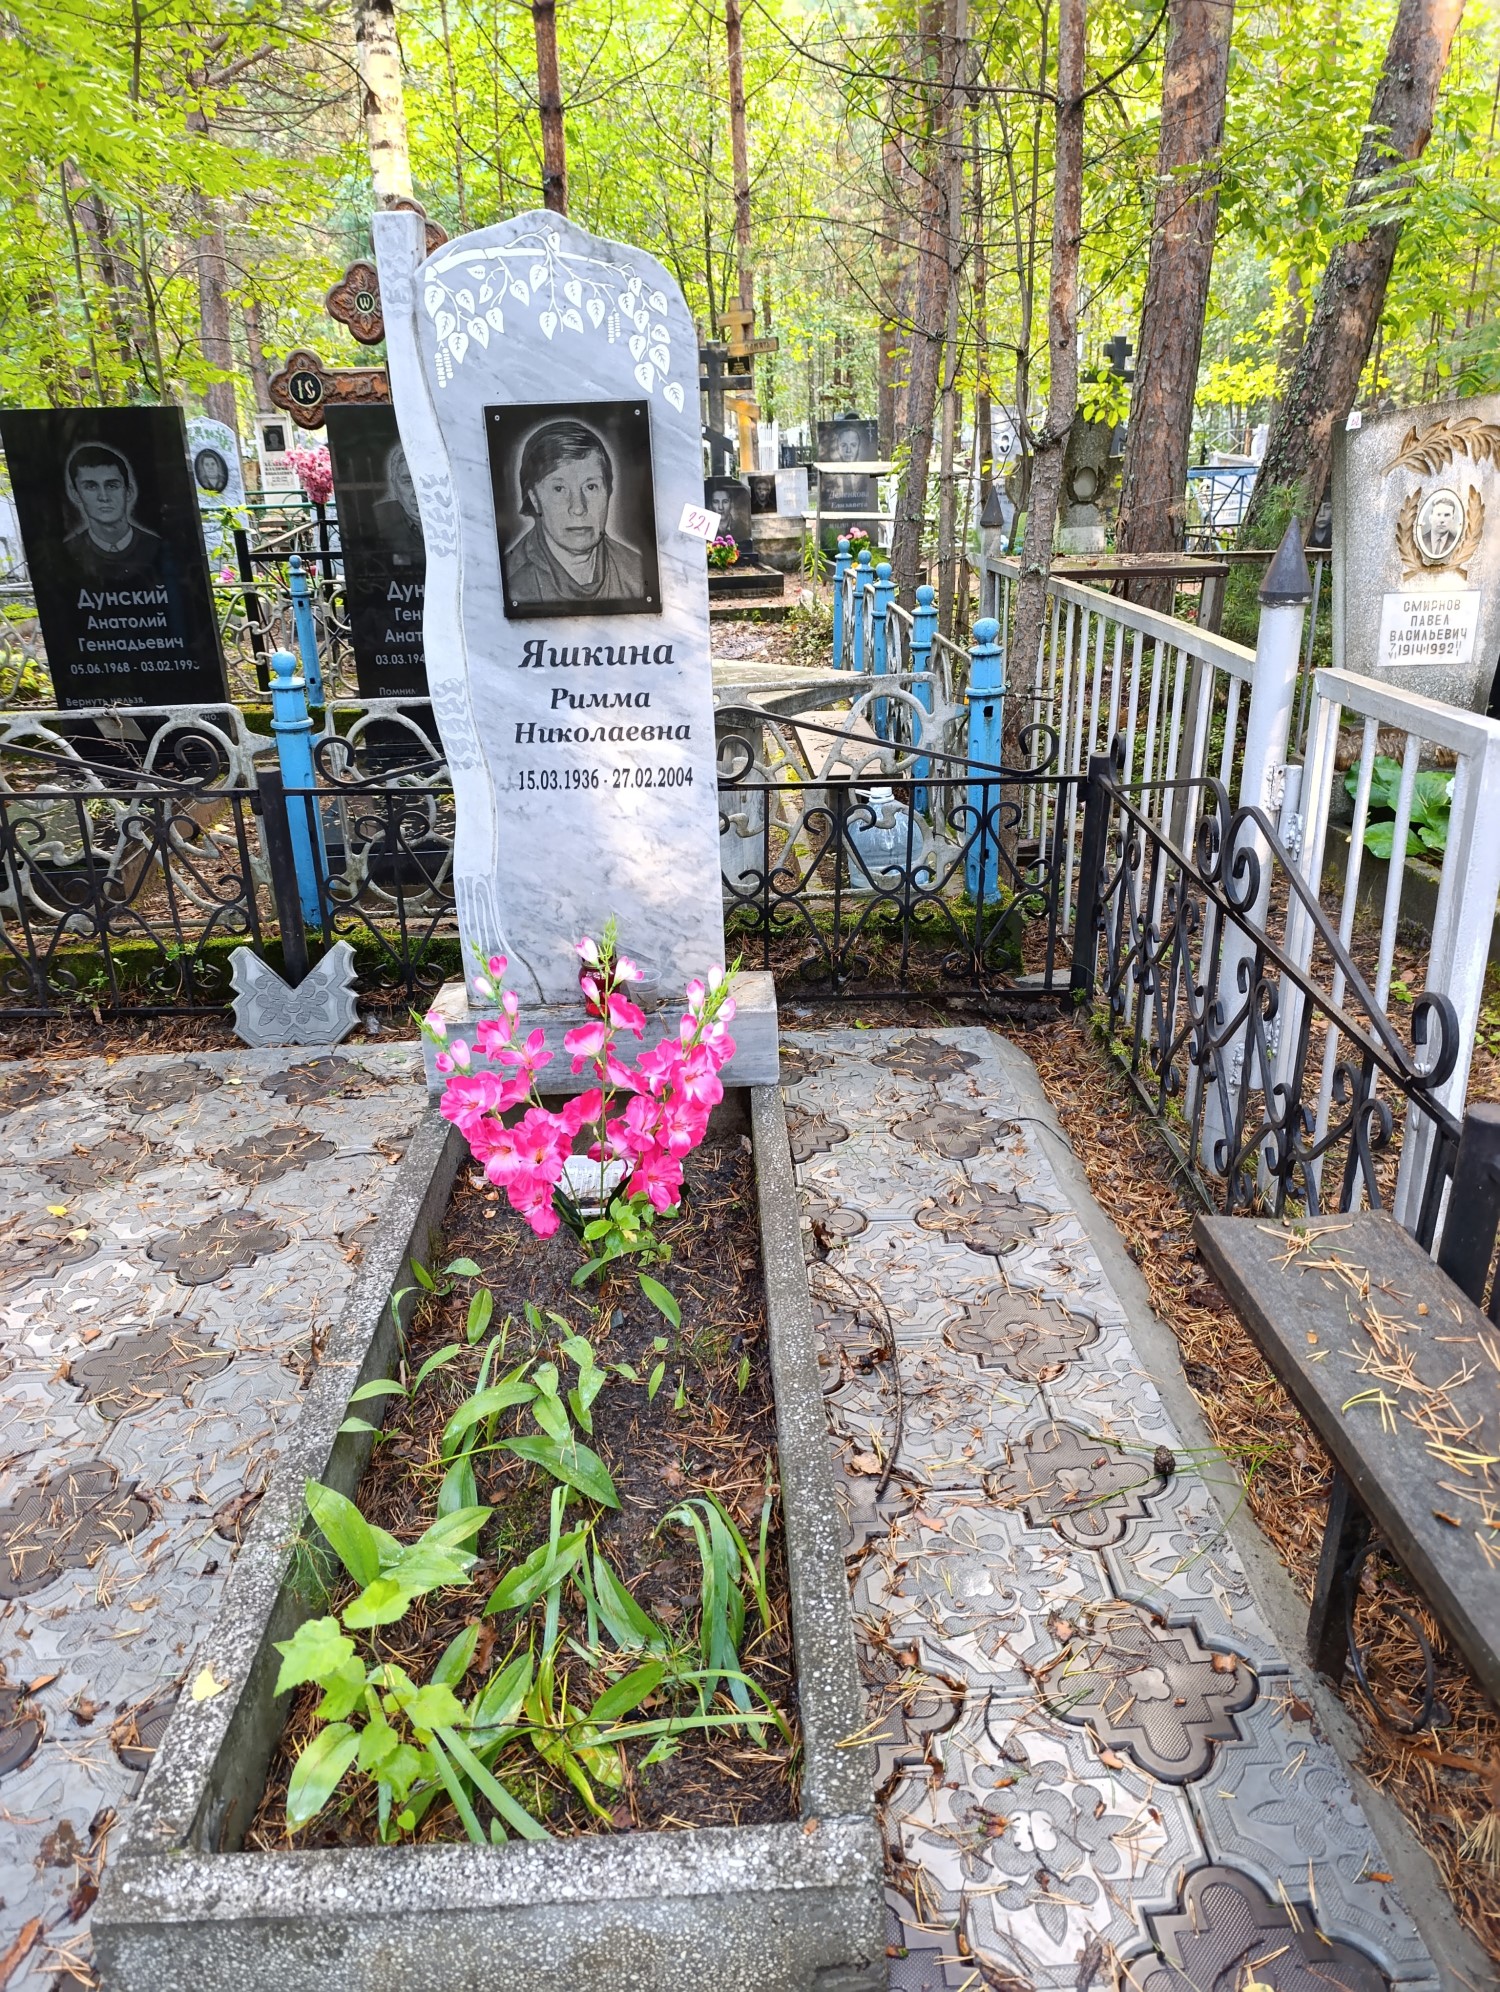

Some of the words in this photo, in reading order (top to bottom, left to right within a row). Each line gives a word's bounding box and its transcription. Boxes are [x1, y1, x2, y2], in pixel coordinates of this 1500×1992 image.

[685, 511, 711, 535] 321
[77, 584, 169, 611] Дунский
[1403, 599, 1461, 612] СМИРНОВ
[87, 612, 168, 630] Анатолий
[395, 608, 424, 621] Ген
[1410, 614, 1449, 627] ПАВЕЛ
[1389, 628, 1468, 642] ВАСИЛЬЕВИЧ
[78, 637, 184, 652] Геннадьевич
[518, 639, 675, 668] Яшкина
[70, 662, 131, 675] 05.06.1968
[66, 697, 108, 708] Вернуть
[550, 688, 651, 710] Римма
[515, 722, 692, 744] Николаевна
[518, 769, 600, 791] 15.03.1936
[612, 766, 693, 788] 27.02.2004
